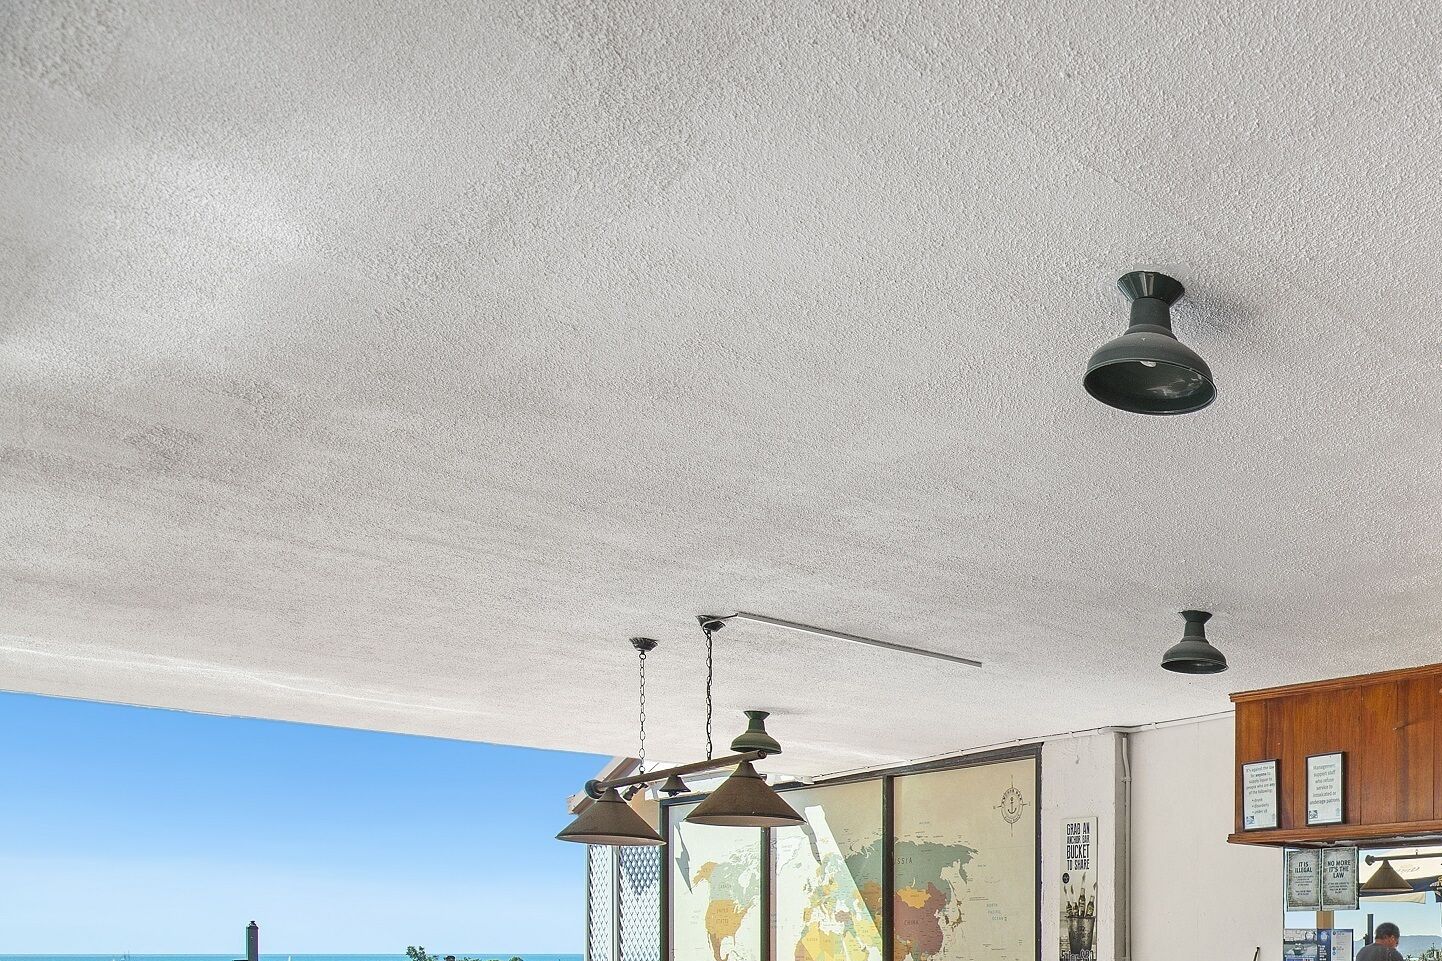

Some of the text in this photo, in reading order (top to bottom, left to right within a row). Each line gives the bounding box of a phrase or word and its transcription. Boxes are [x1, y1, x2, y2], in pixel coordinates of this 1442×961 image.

[1066, 822, 1090, 835] GRAB AN
[1066, 844, 1090, 859] BUCKET
[1067, 858, 1090, 870] TO SHARE
